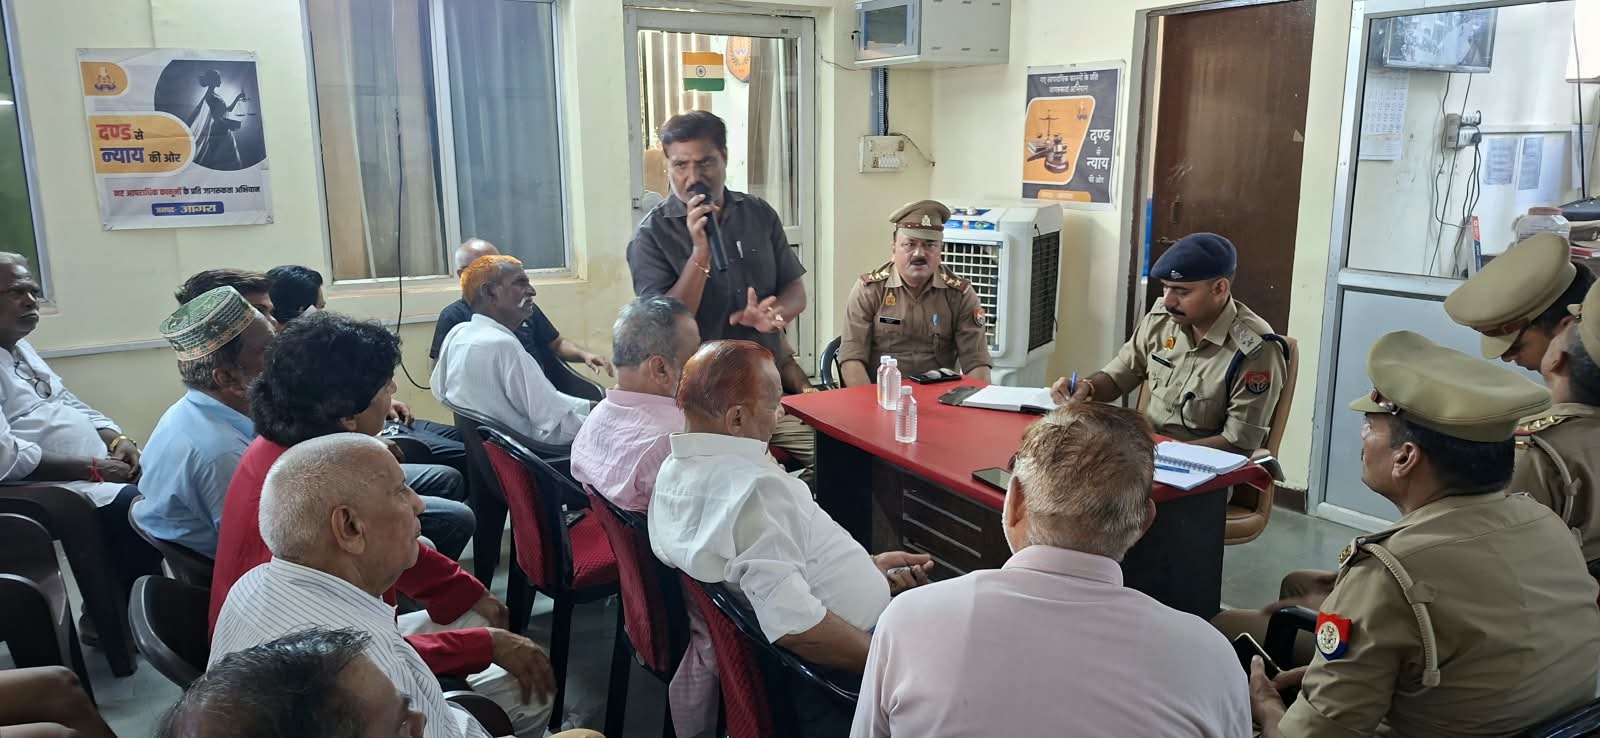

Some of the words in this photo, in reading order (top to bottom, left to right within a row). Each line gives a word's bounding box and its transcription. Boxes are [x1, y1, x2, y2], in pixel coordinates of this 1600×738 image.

[96, 124, 131, 140] दण्ड
[133, 129, 144, 140] से
[1089, 129, 1112, 144] दण्ड
[99, 148, 144, 163] न्याय
[148, 151, 161, 162] की
[163, 151, 181, 162] ओर
[1086, 157, 1110, 169] न्याय
[183, 186, 189, 195] के
[191, 186, 201, 194] प्रति
[235, 185, 260, 193] अभियान
[181, 204, 216, 213] आगरा
